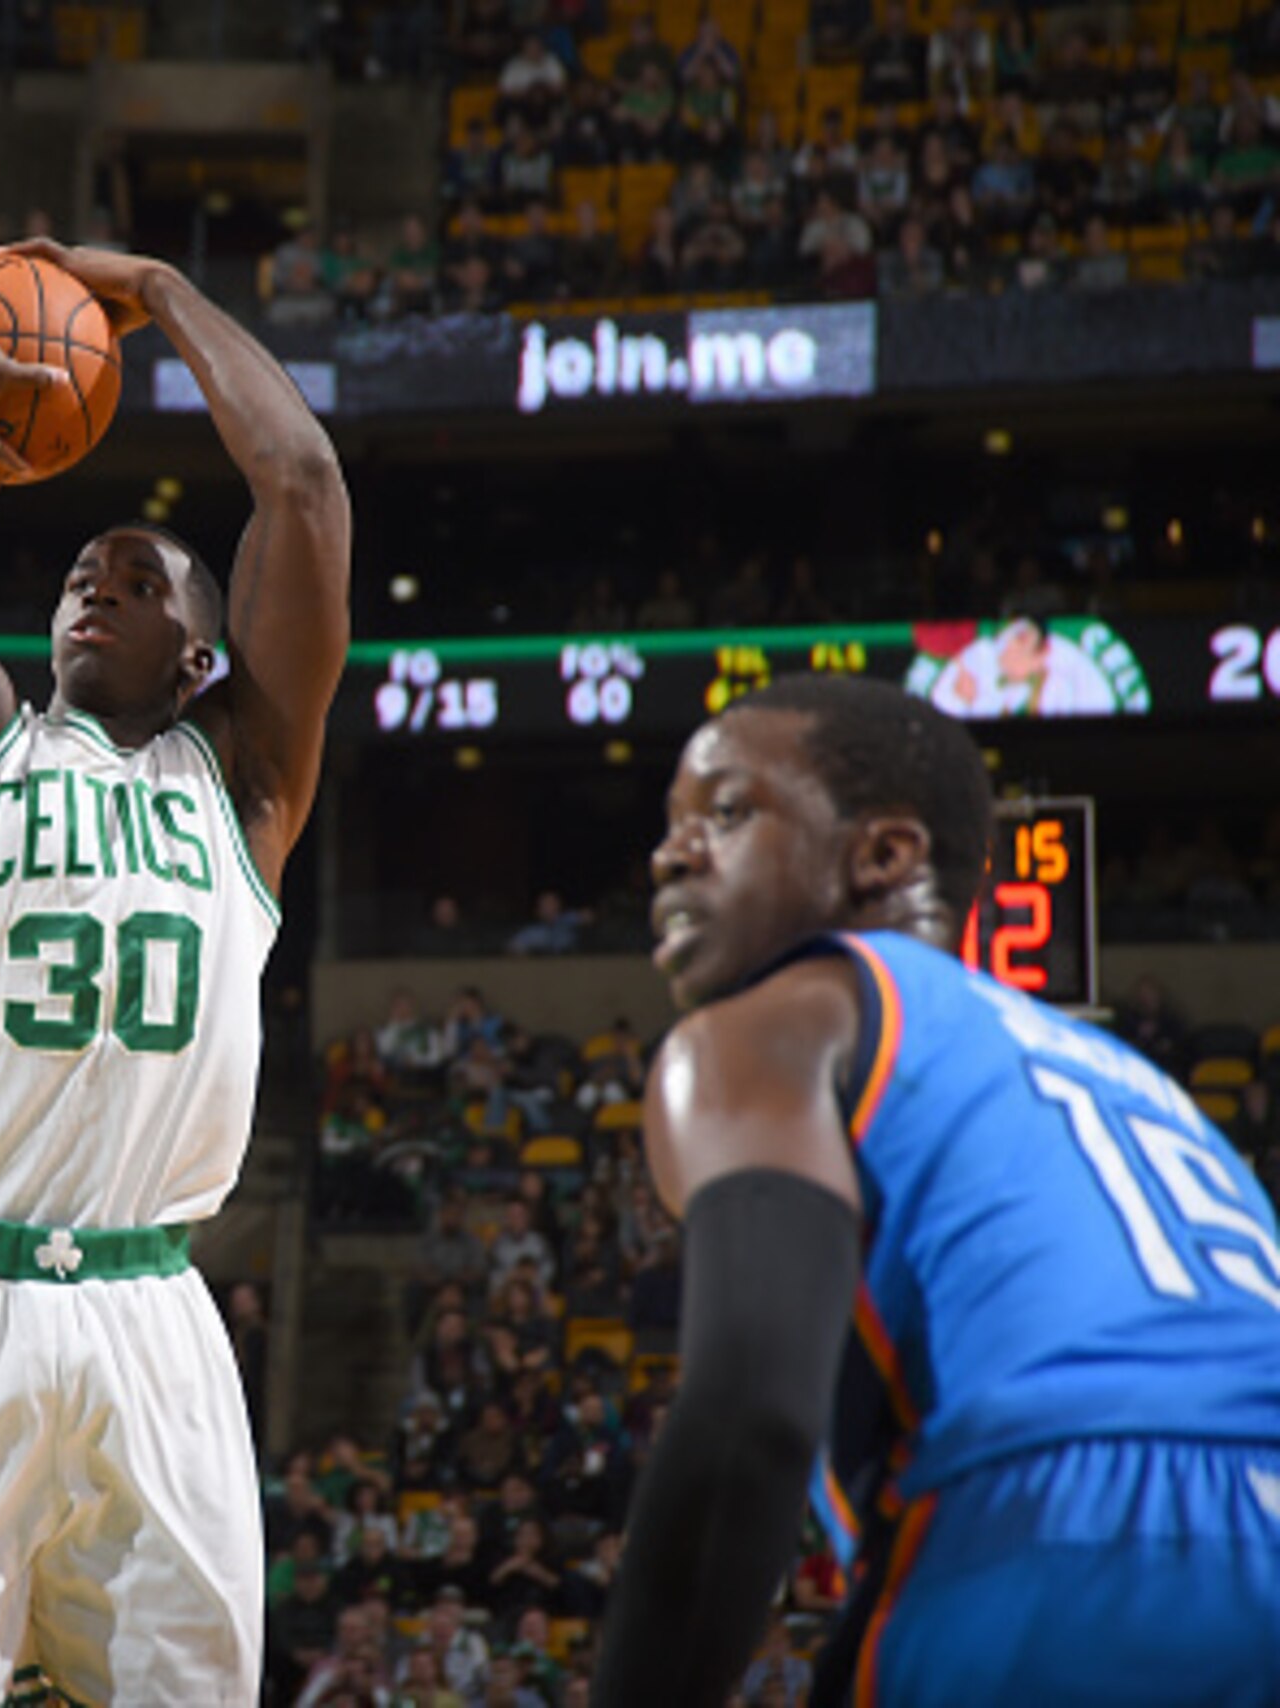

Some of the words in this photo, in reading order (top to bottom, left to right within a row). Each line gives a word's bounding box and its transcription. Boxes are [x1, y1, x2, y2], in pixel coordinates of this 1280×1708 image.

[518, 317, 817, 414] join.me
[375, 677, 499, 732] 9/15
[567, 675, 632, 726] 60
[1014, 819, 1070, 884] 15
[3, 910, 204, 1056] 30
[1023, 1054, 1280, 1312] 15
